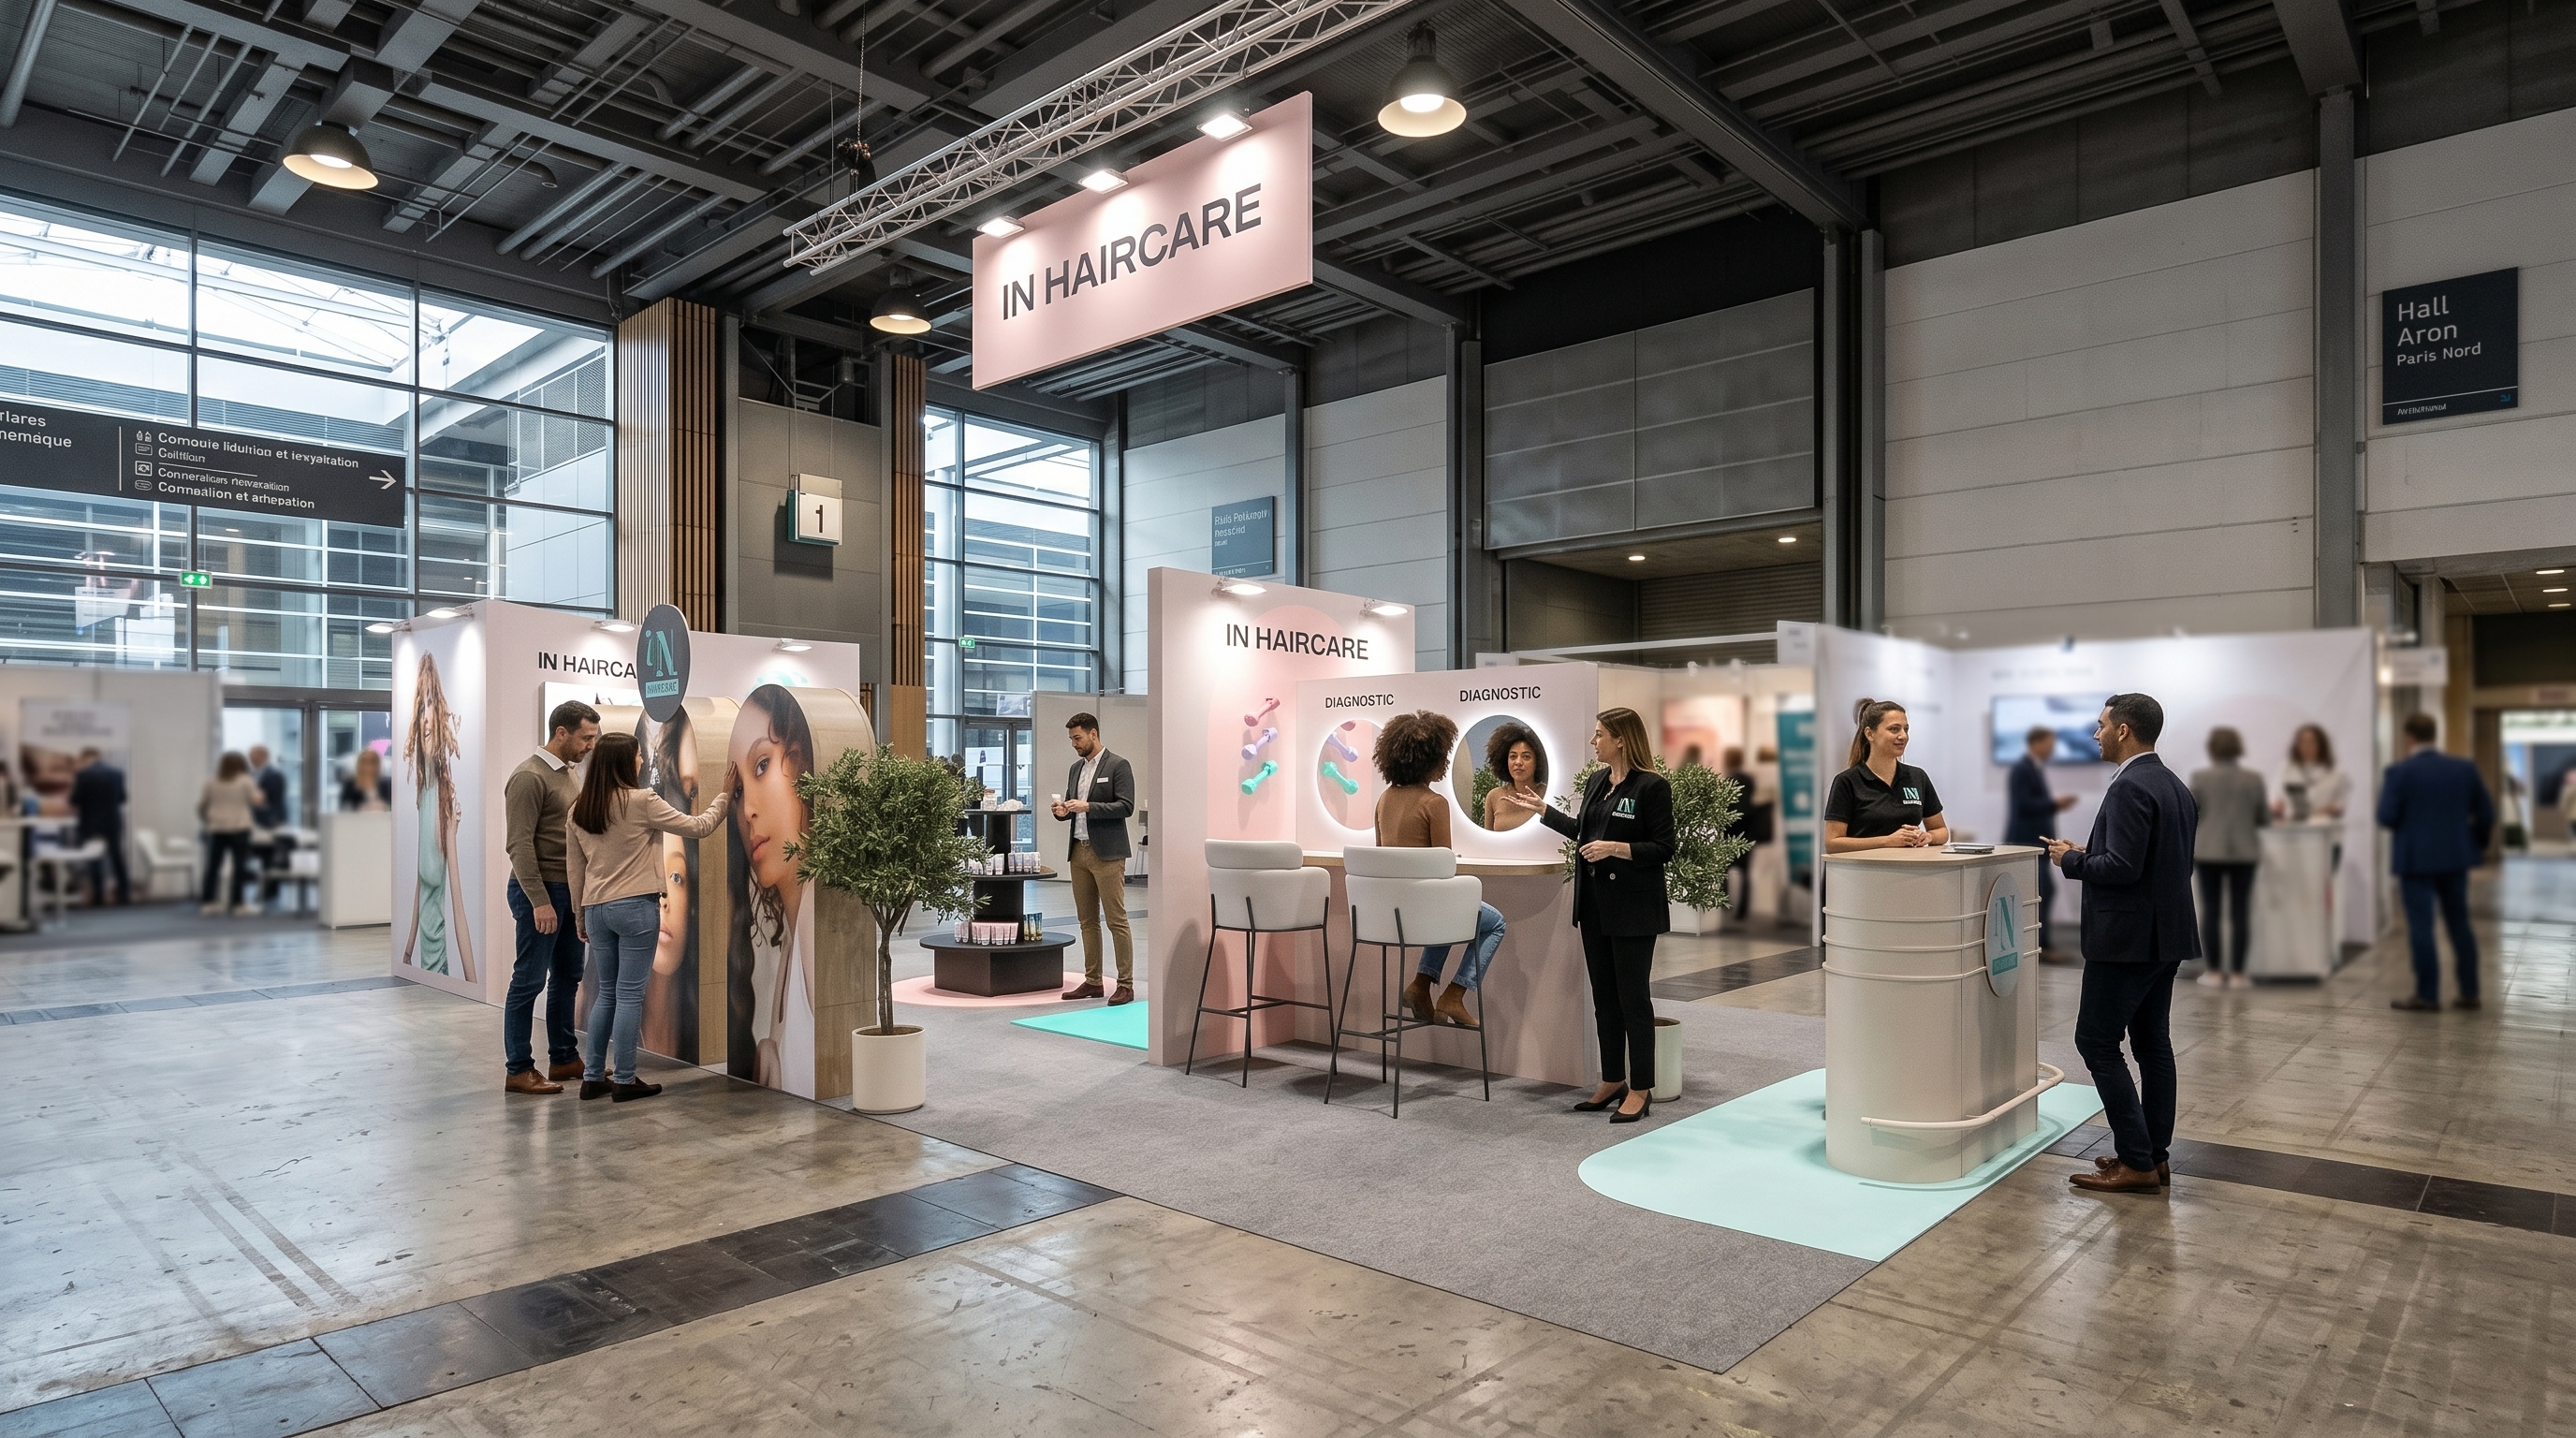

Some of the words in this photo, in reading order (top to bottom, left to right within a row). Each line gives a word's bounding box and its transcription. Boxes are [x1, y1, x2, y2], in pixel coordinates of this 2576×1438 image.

[1003, 273, 1034, 320] IN
[1045, 183, 1262, 305] HAIRCARE
[2398, 295, 2450, 322] Hall
[2397, 324, 2458, 346] Aron
[2397, 350, 2437, 366] Paris
[2443, 342, 2481, 360] Nord
[276, 449, 289, 460] et
[236, 492, 249, 502] et
[815, 505, 824, 534] 1
[1225, 624, 1250, 648] IN
[1255, 626, 1369, 661] HAIRCARE
[538, 652, 558, 670] IN
[563, 654, 637, 680] HAIRCA
[1325, 693, 1395, 709] DIAGNOSTIC
[1459, 685, 1542, 702] DIAGNOSTIC
